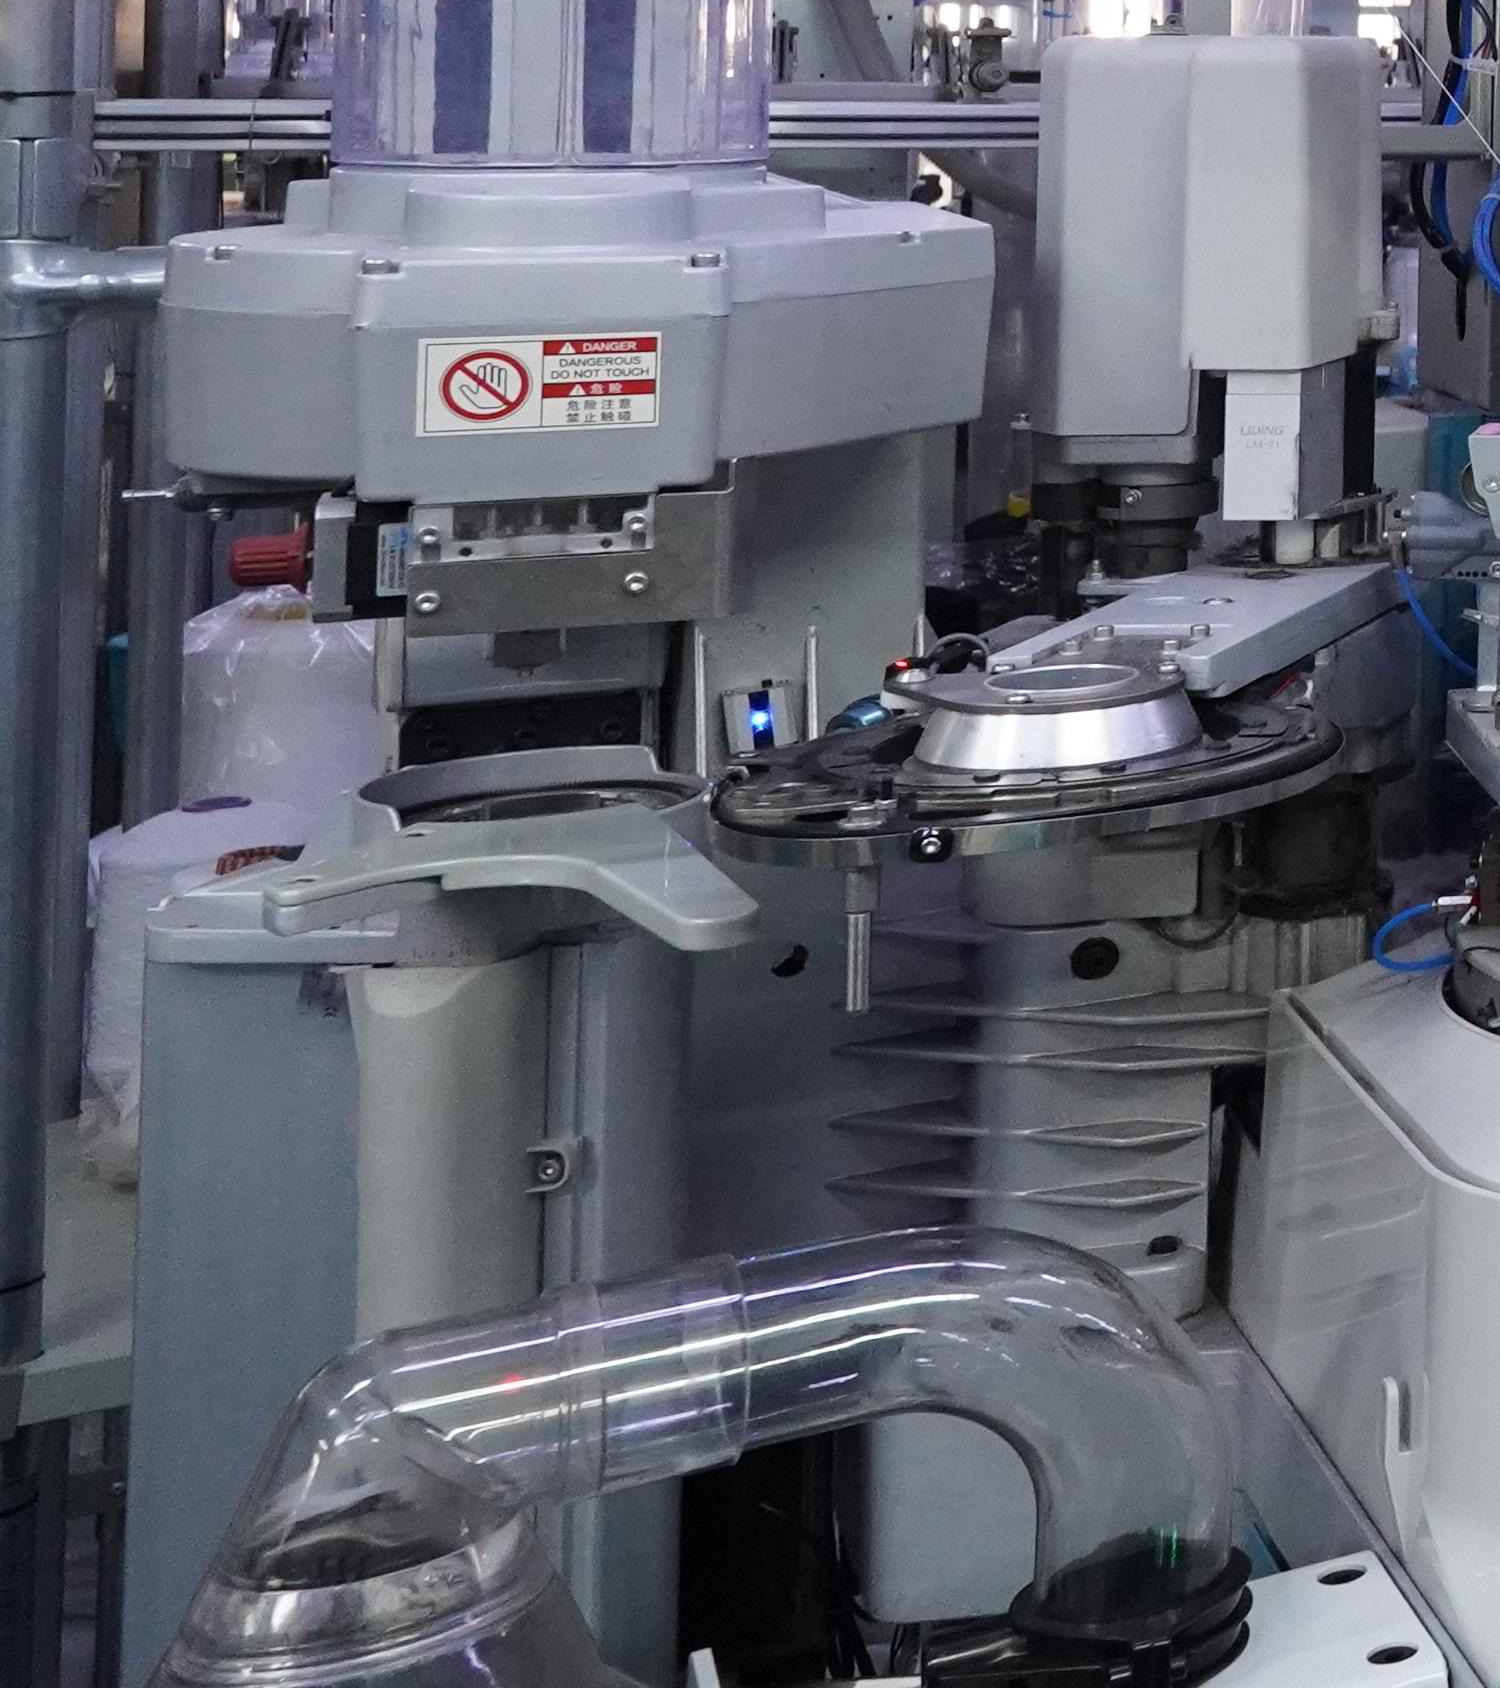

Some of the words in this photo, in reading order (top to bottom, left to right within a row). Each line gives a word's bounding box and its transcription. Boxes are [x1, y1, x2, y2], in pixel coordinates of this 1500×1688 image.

[582, 341, 637, 353] DANGER
[559, 356, 641, 368] DANGEROUS
[551, 370, 570, 380] DO
[573, 369, 600, 379] NOT
[605, 367, 650, 378] TOUCH
[590, 383, 623, 395] 危险
